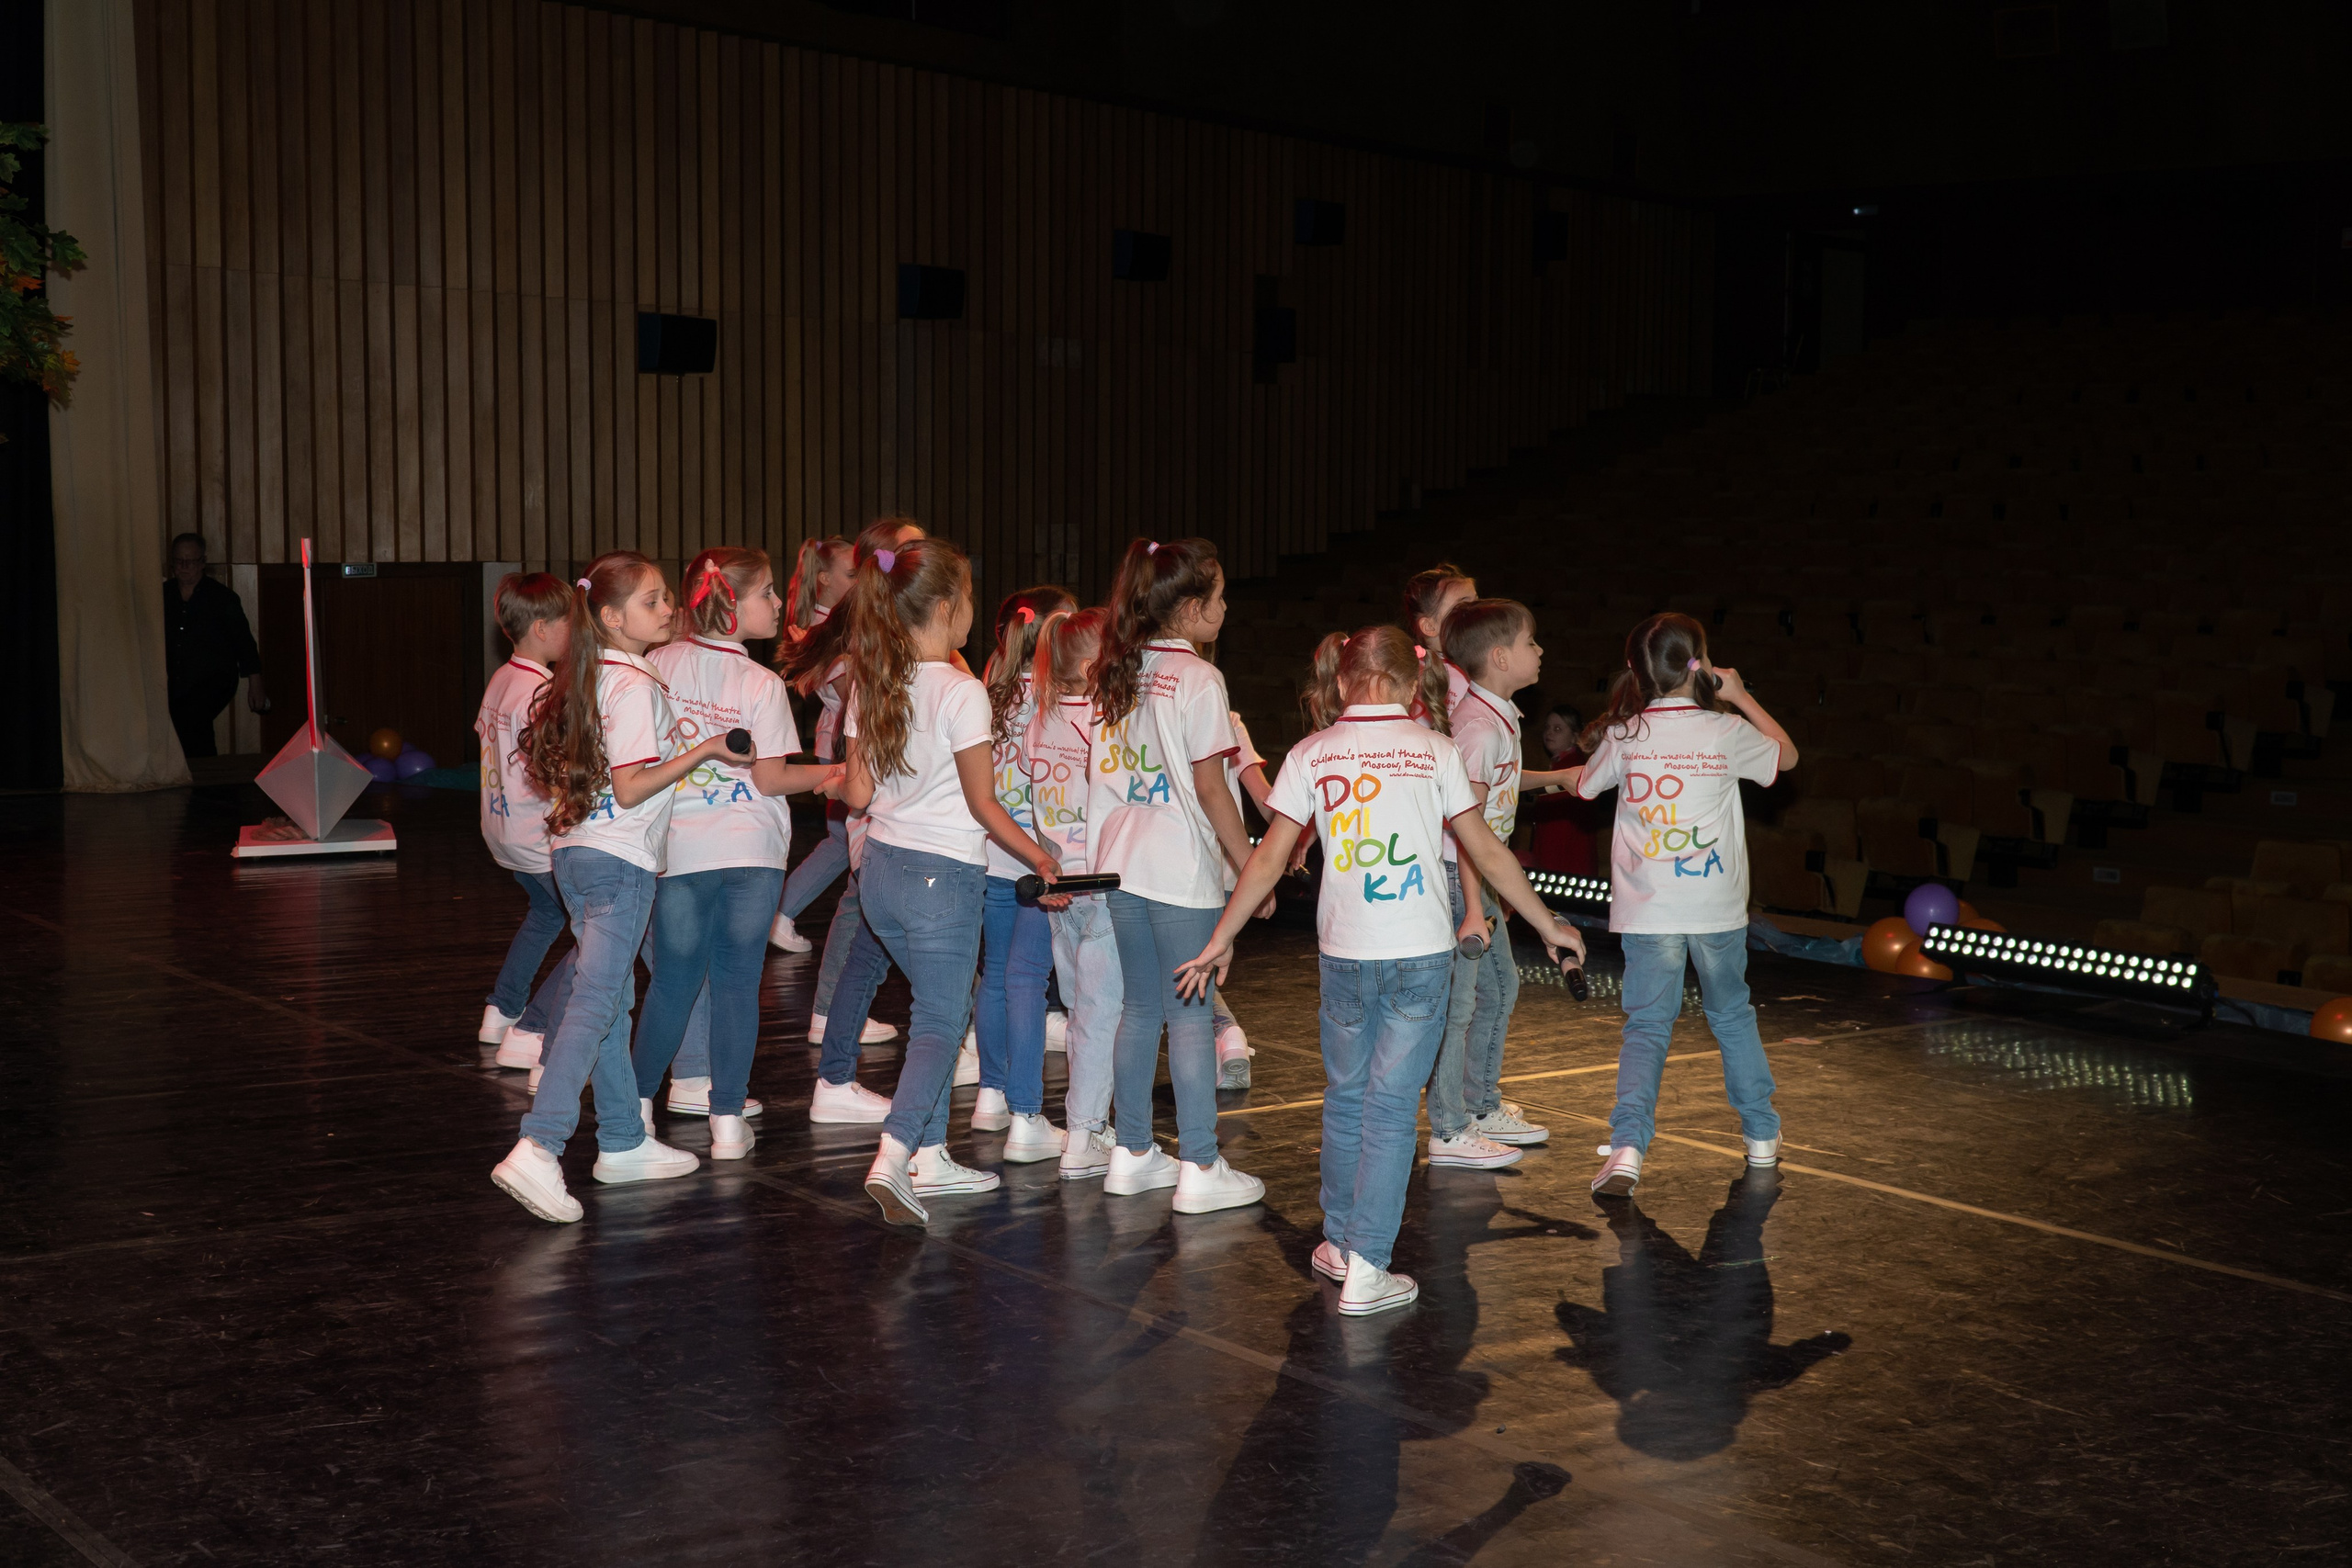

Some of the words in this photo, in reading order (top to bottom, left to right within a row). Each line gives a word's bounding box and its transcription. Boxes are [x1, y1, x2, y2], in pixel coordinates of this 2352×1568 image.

[1153, 681, 1176, 692] Russia
[711, 702, 741, 715] theatre
[714, 713, 740, 724] Russia
[1100, 744, 1162, 773] SOL
[1311, 749, 1355, 768] Children's
[1358, 749, 1395, 760] musical
[1397, 749, 1436, 763] theatre
[1362, 761, 1401, 773] Moscow,
[1405, 760, 1434, 772] Russia
[1621, 750, 1657, 761] Children's
[1660, 751, 1693, 761] musical
[1664, 761, 1699, 773] Moscow,
[1702, 761, 1728, 771] Russia
[1029, 758, 1071, 784] DO
[1038, 785, 1065, 807] MI
[1127, 773, 1170, 805] KA
[1315, 773, 1382, 812] DO
[1625, 773, 1684, 803] DO
[1330, 807, 1371, 838] MI
[1638, 803, 1677, 827] MI
[1334, 833, 1418, 873] SOL
[1644, 826, 1719, 858] SOL
[1674, 848, 1724, 877] KA
[1363, 863, 1425, 903] KA
